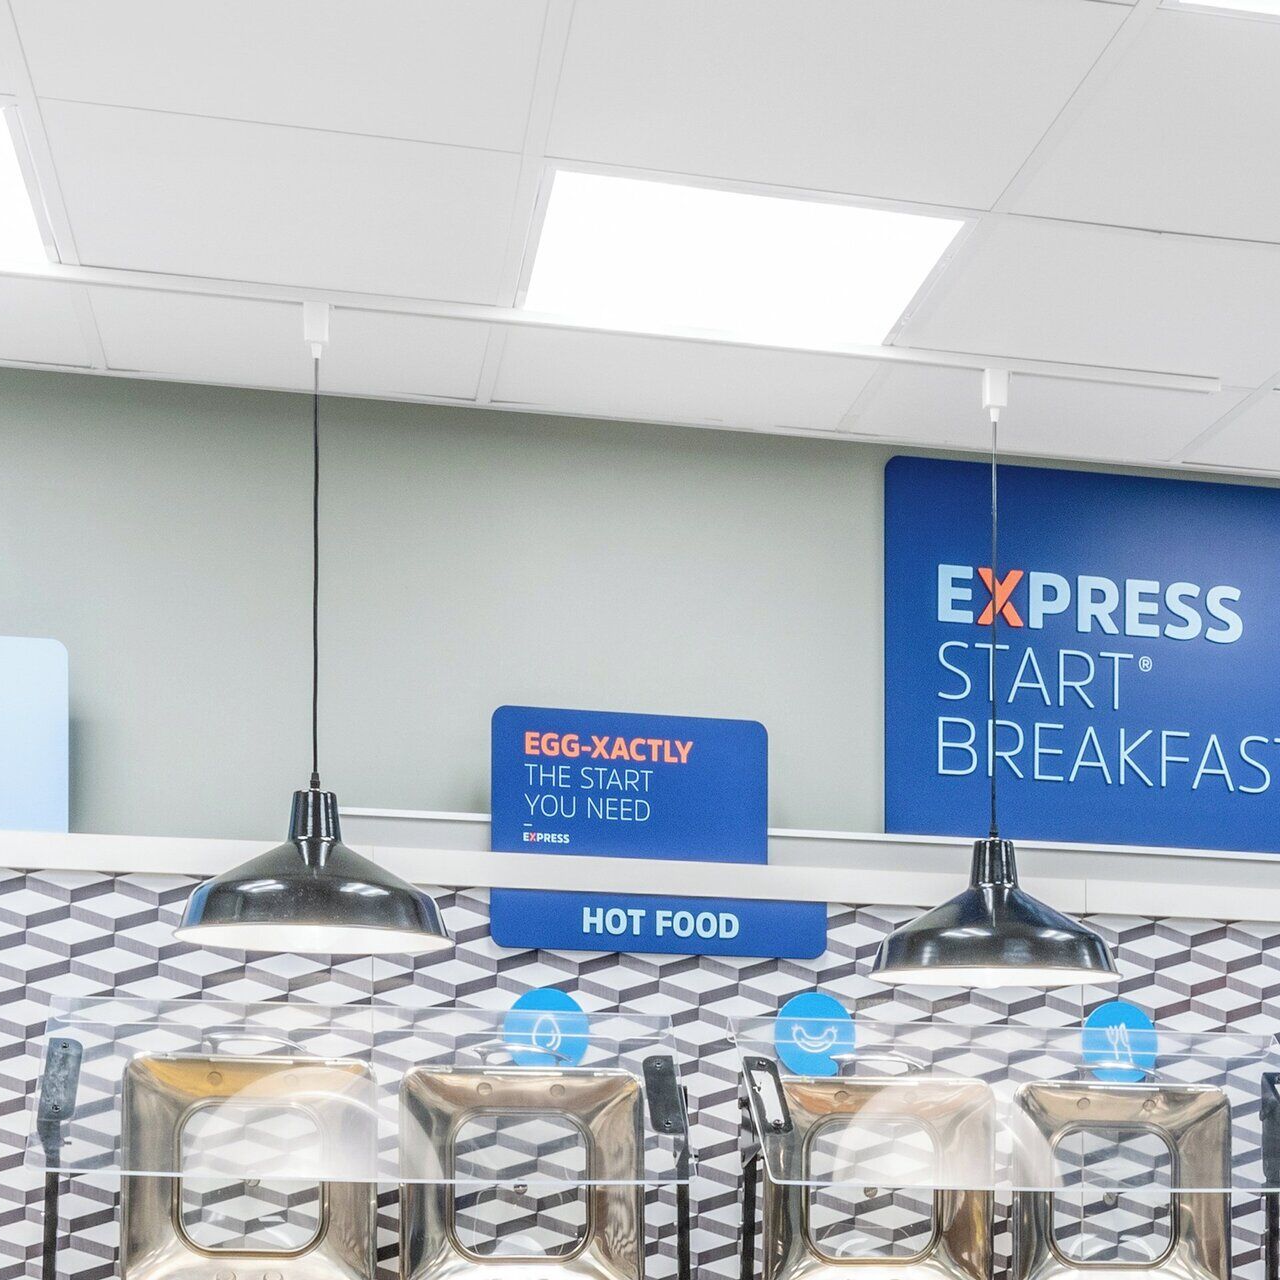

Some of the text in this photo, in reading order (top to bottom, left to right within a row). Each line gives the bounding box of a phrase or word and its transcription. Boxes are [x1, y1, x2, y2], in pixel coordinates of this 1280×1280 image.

[937, 563, 1244, 644] EXPRESS
[524, 732, 693, 764] EGG-XACTLY
[524, 763, 654, 792] THE START
[524, 793, 651, 822] YOU NEED
[522, 832, 570, 844] EXPRESS
[582, 906, 739, 939] HOT FOOD
